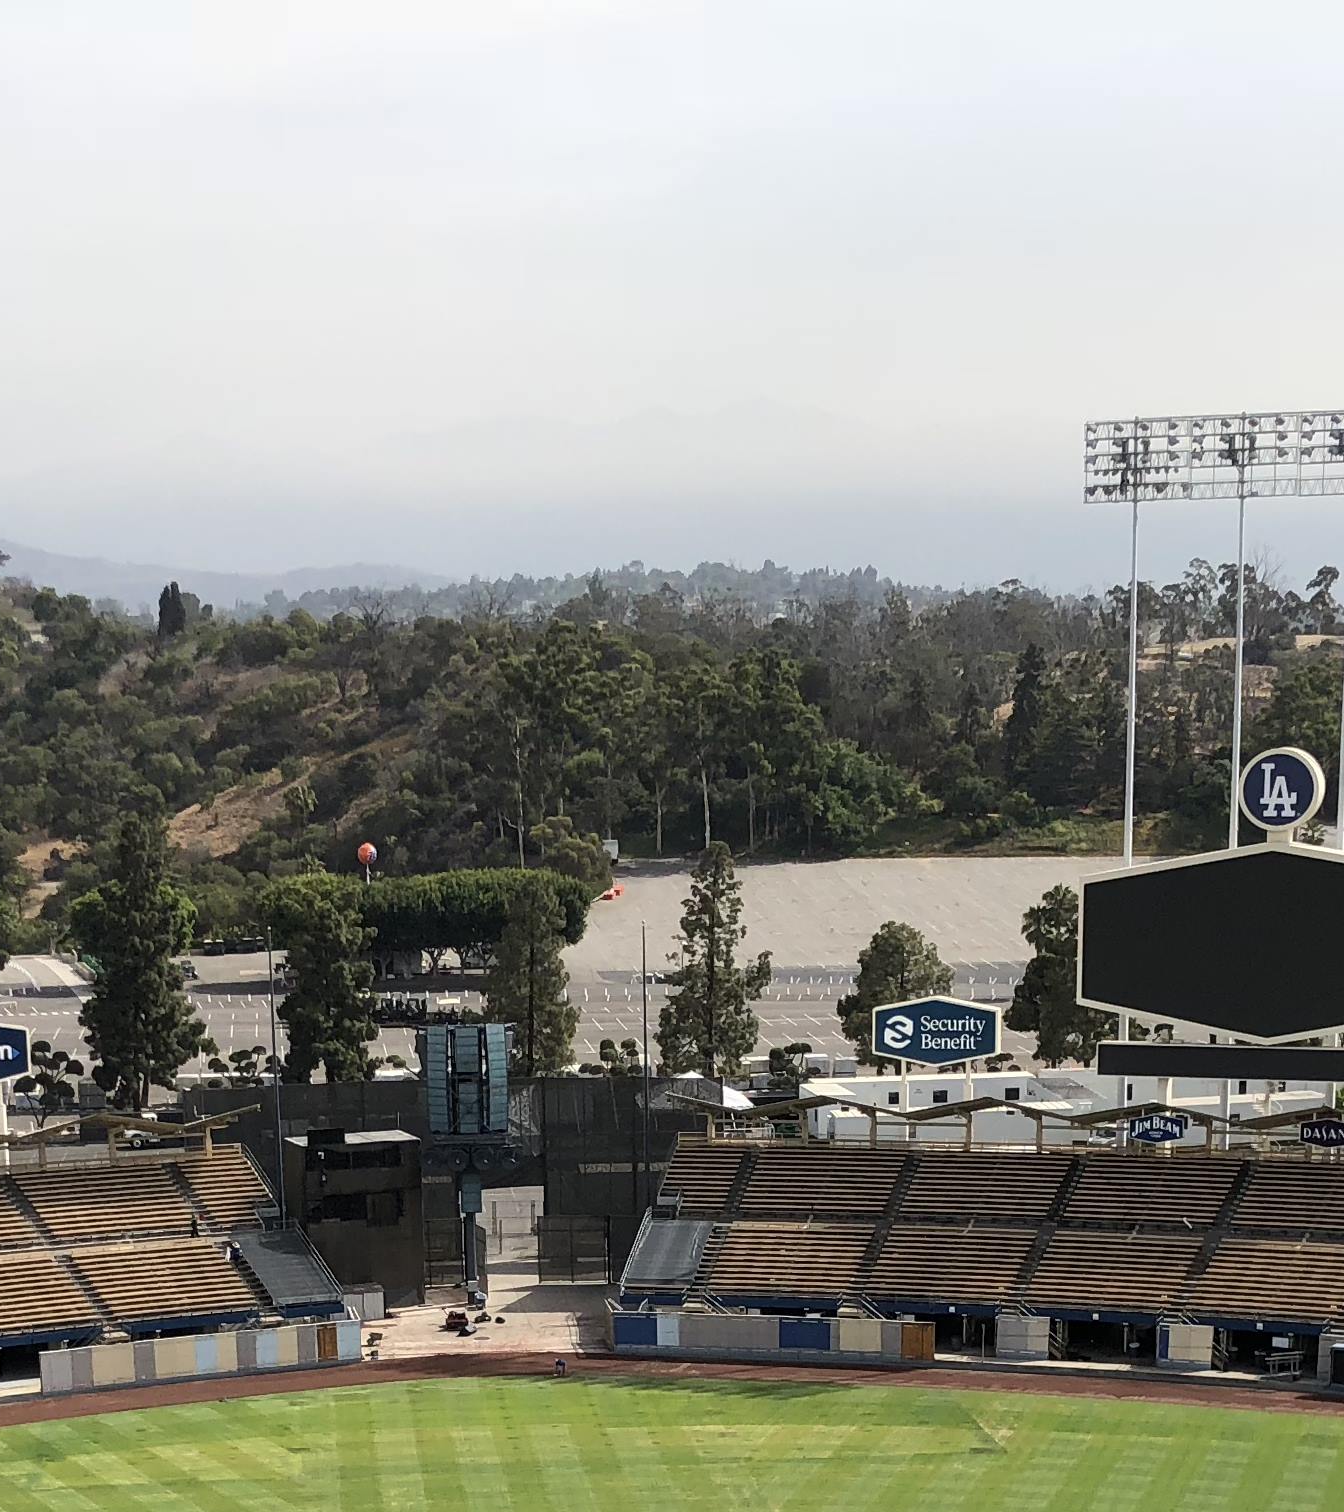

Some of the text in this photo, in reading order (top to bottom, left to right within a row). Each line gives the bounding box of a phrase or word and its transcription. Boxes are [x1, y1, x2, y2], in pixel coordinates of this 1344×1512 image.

[1259, 762, 1298, 818] LA
[919, 1015, 987, 1036] Security
[920, 1033, 977, 1050] Benefit
[1131, 1116, 1181, 1138] JIM BEAM
